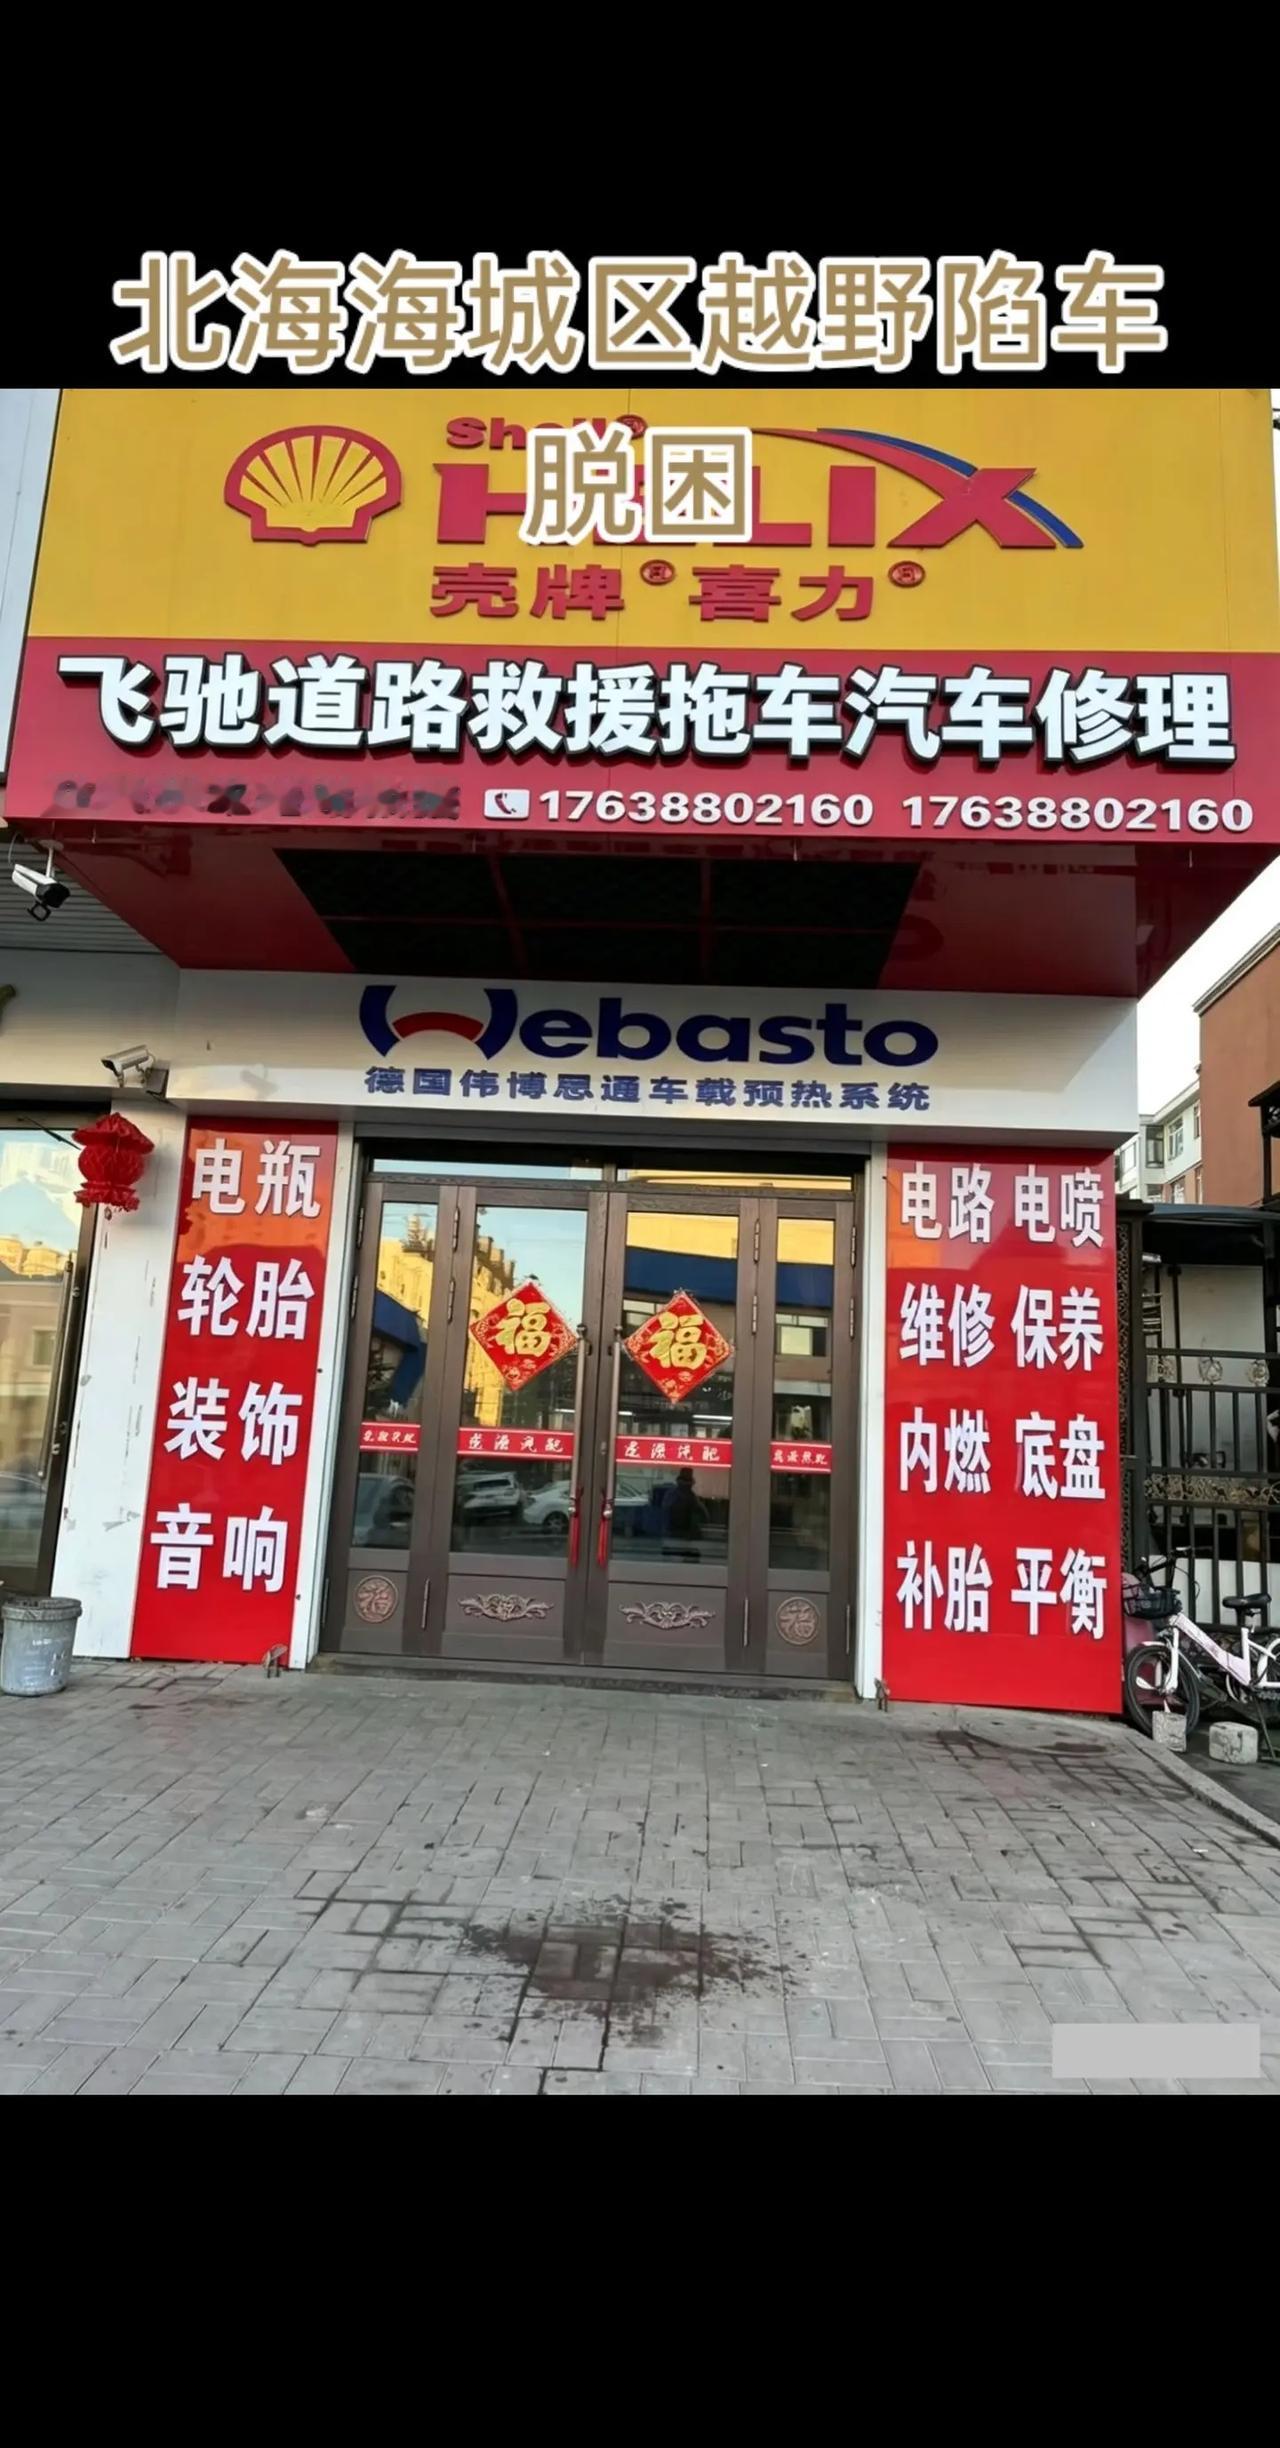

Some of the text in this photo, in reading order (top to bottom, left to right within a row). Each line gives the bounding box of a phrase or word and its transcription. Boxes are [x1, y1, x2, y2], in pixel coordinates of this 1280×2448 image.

[430, 562, 874, 623] 壳牌 喜力
[58, 652, 1238, 768] 飞驰道路救援拖车汽车修理
[539, 790, 1253, 831] 17638802160 17638802160
[359, 984, 939, 1067] Webasto
[192, 1138, 321, 1218] 电瓶
[901, 1162, 1105, 1248] 电路 电喷
[177, 1255, 315, 1340] 轮胎
[494, 1297, 551, 1357] 福
[649, 1310, 707, 1370] 福
[899, 1282, 1104, 1372] 维修 保养
[164, 1377, 303, 1465] 装饰
[899, 1406, 1106, 1500] 内燃 底盘
[150, 1502, 288, 1592] 音响
[896, 1540, 1107, 1640] 补胎 平衡
